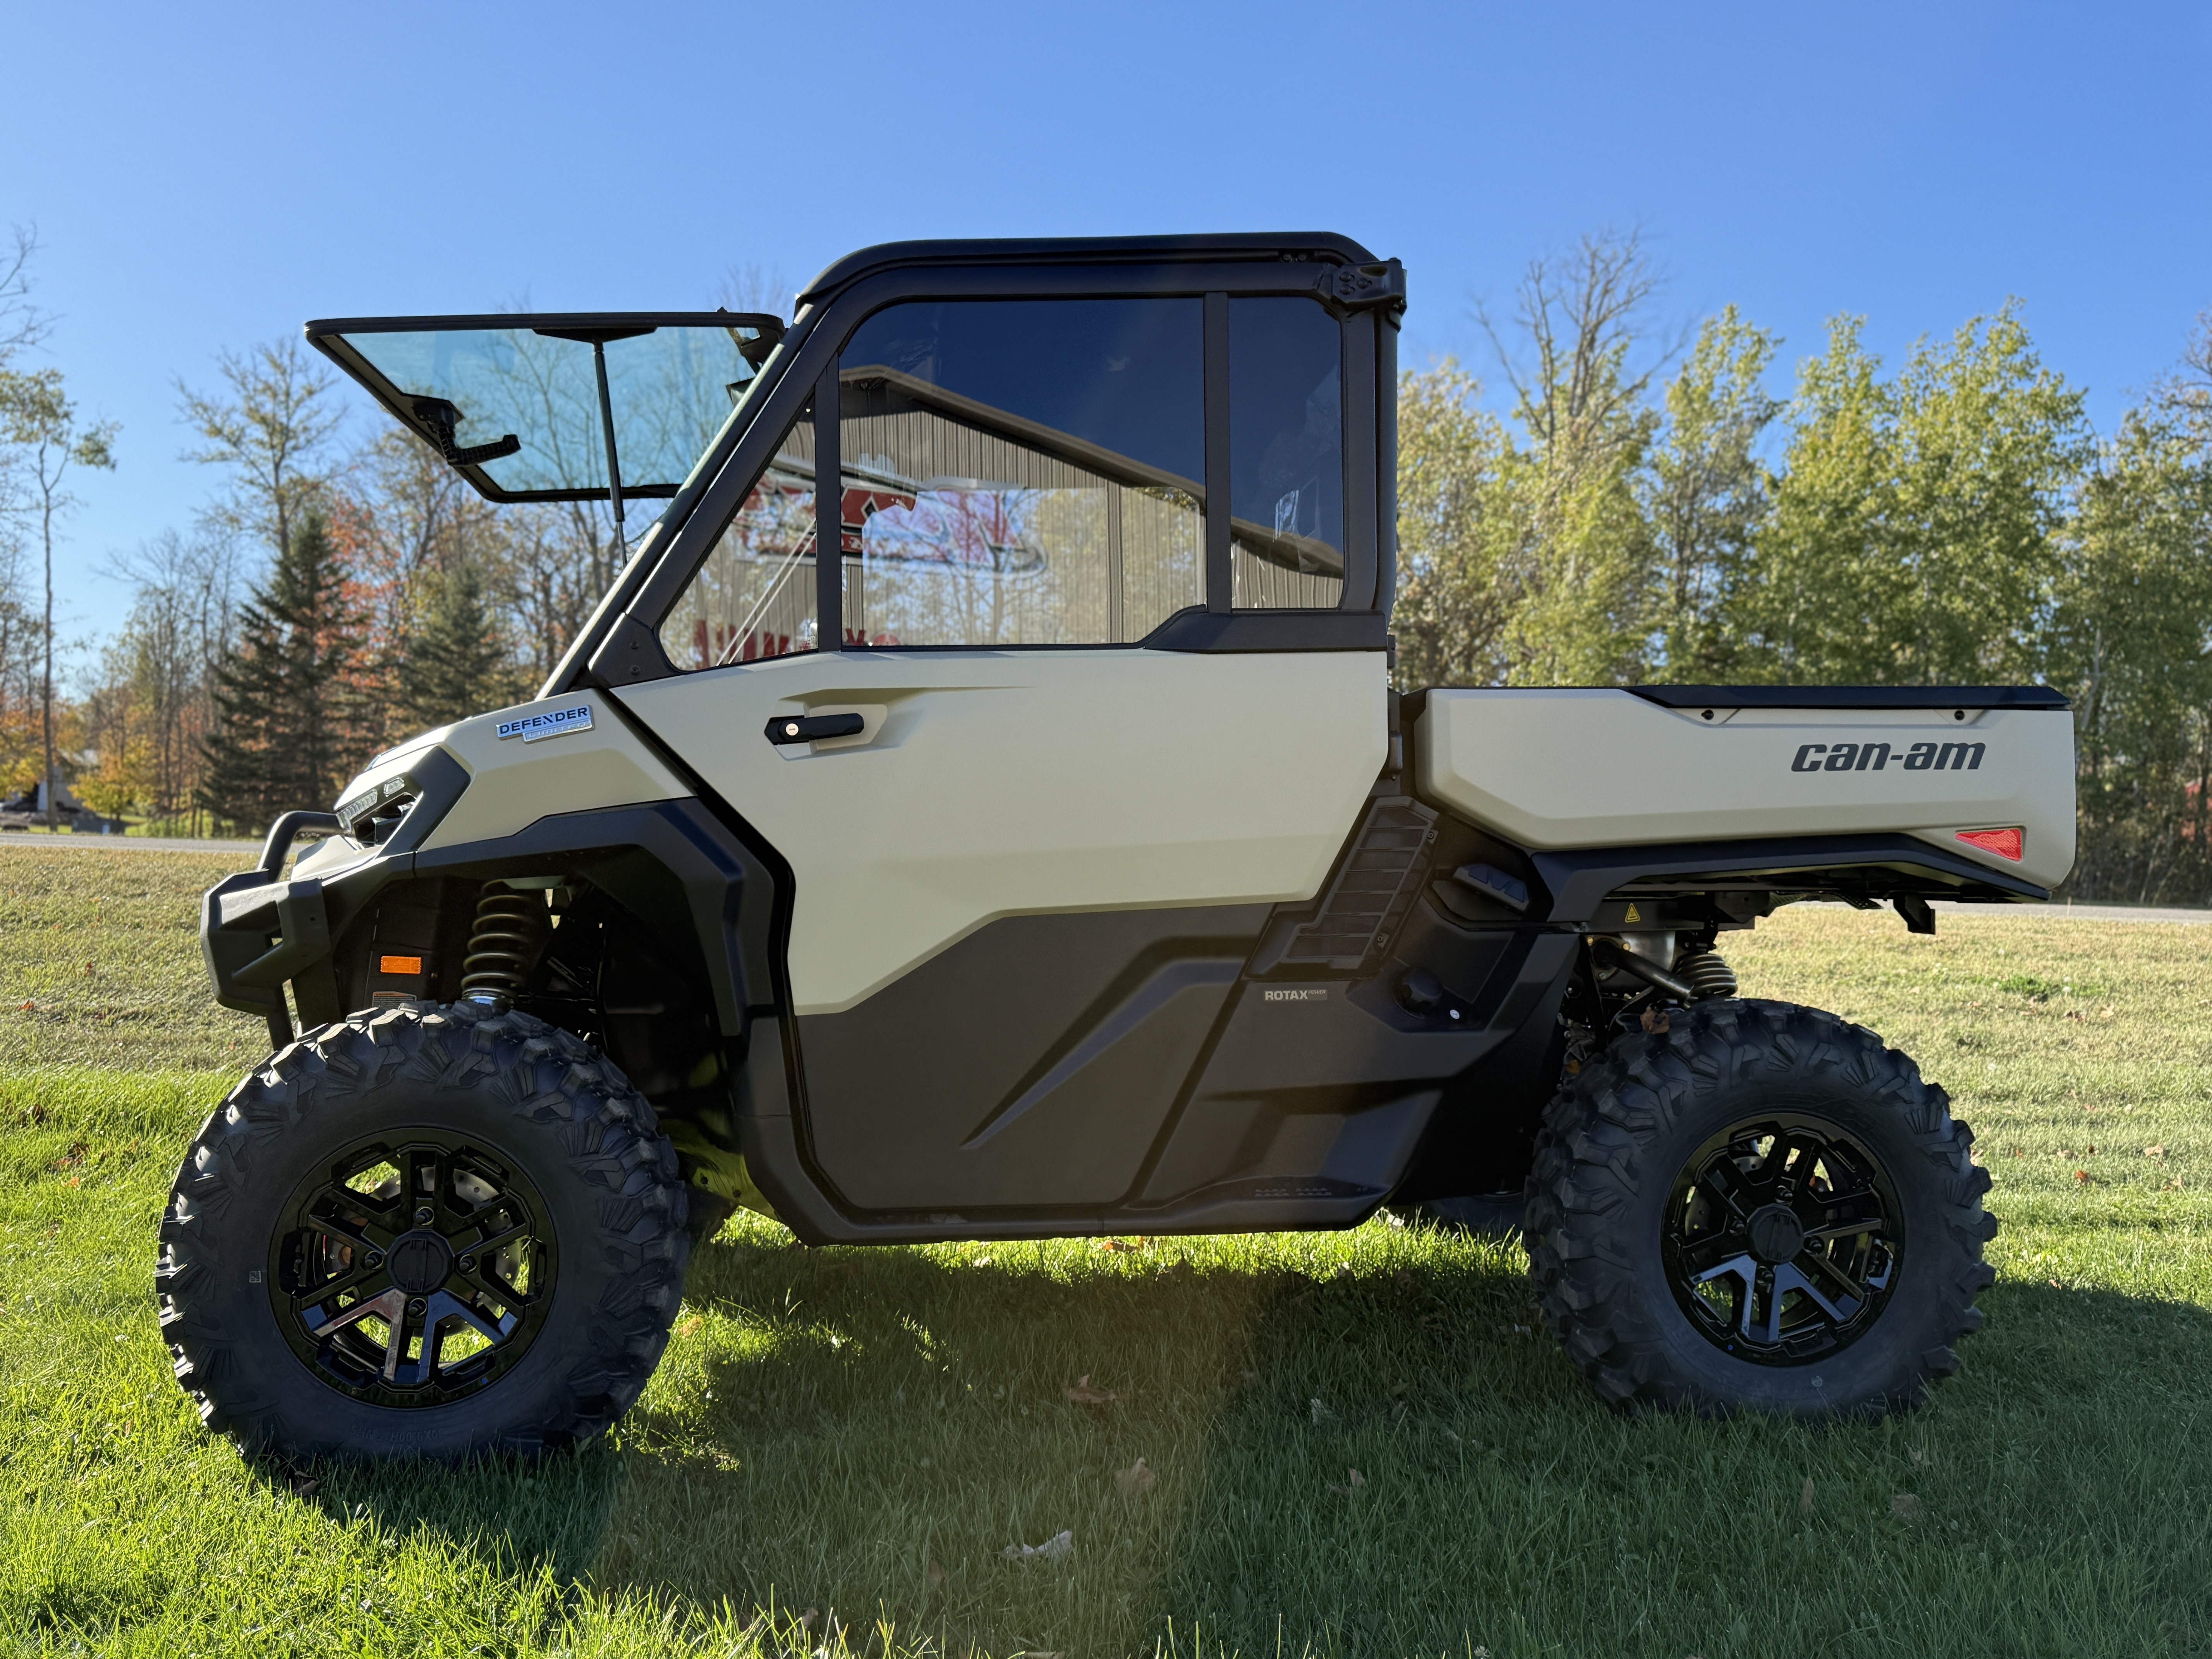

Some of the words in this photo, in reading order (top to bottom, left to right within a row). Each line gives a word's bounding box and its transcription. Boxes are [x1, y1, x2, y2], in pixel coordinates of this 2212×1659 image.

[500, 707, 587, 734] DEFENDER
[1791, 742, 1986, 772] can-am
[1265, 990, 1308, 1000] ROTAX
